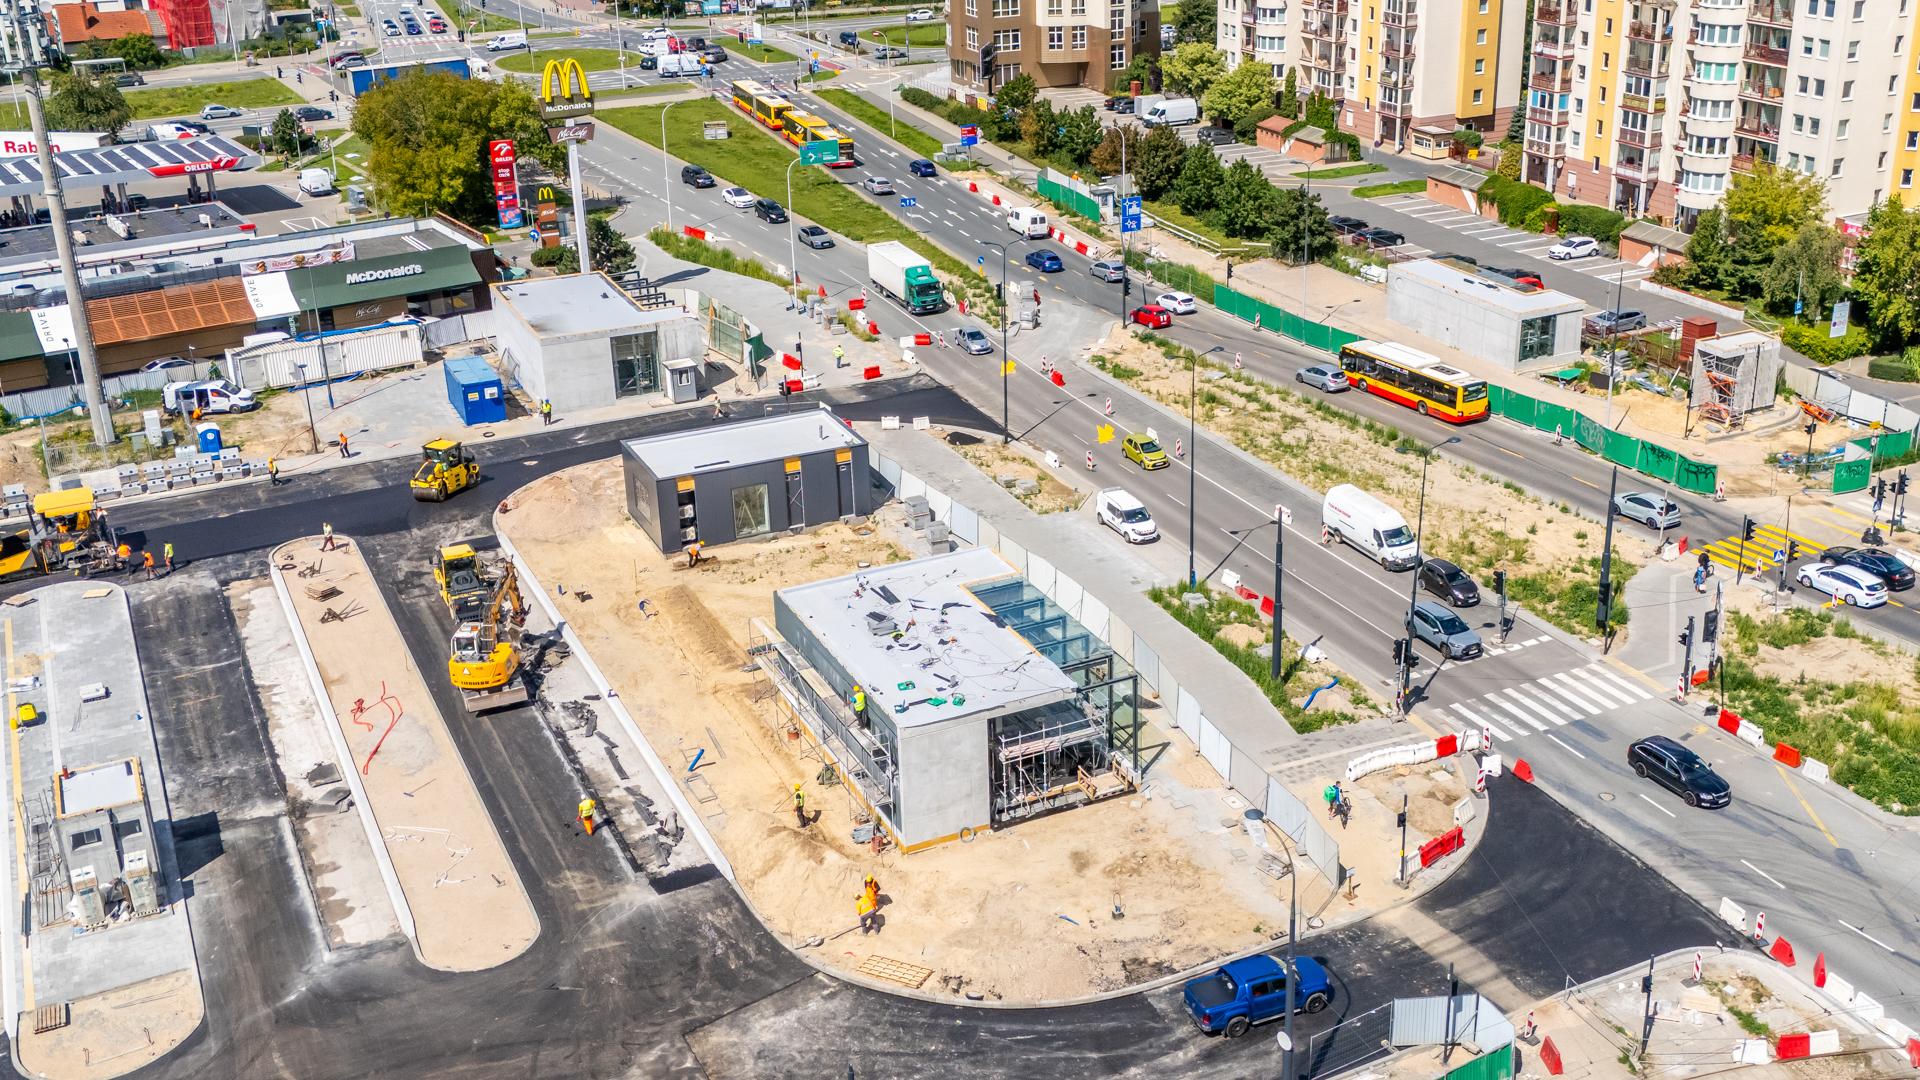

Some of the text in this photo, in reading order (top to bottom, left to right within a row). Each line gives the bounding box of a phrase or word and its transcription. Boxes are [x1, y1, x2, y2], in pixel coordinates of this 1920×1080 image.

[545, 102, 592, 113] McDonald's
[4, 141, 61, 153] Rabn
[184, 162, 212, 173] ORLEN
[346, 264, 423, 285] McDonald's
[247, 279, 264, 308] DRIVE
[37, 311, 55, 342] DRIVE
